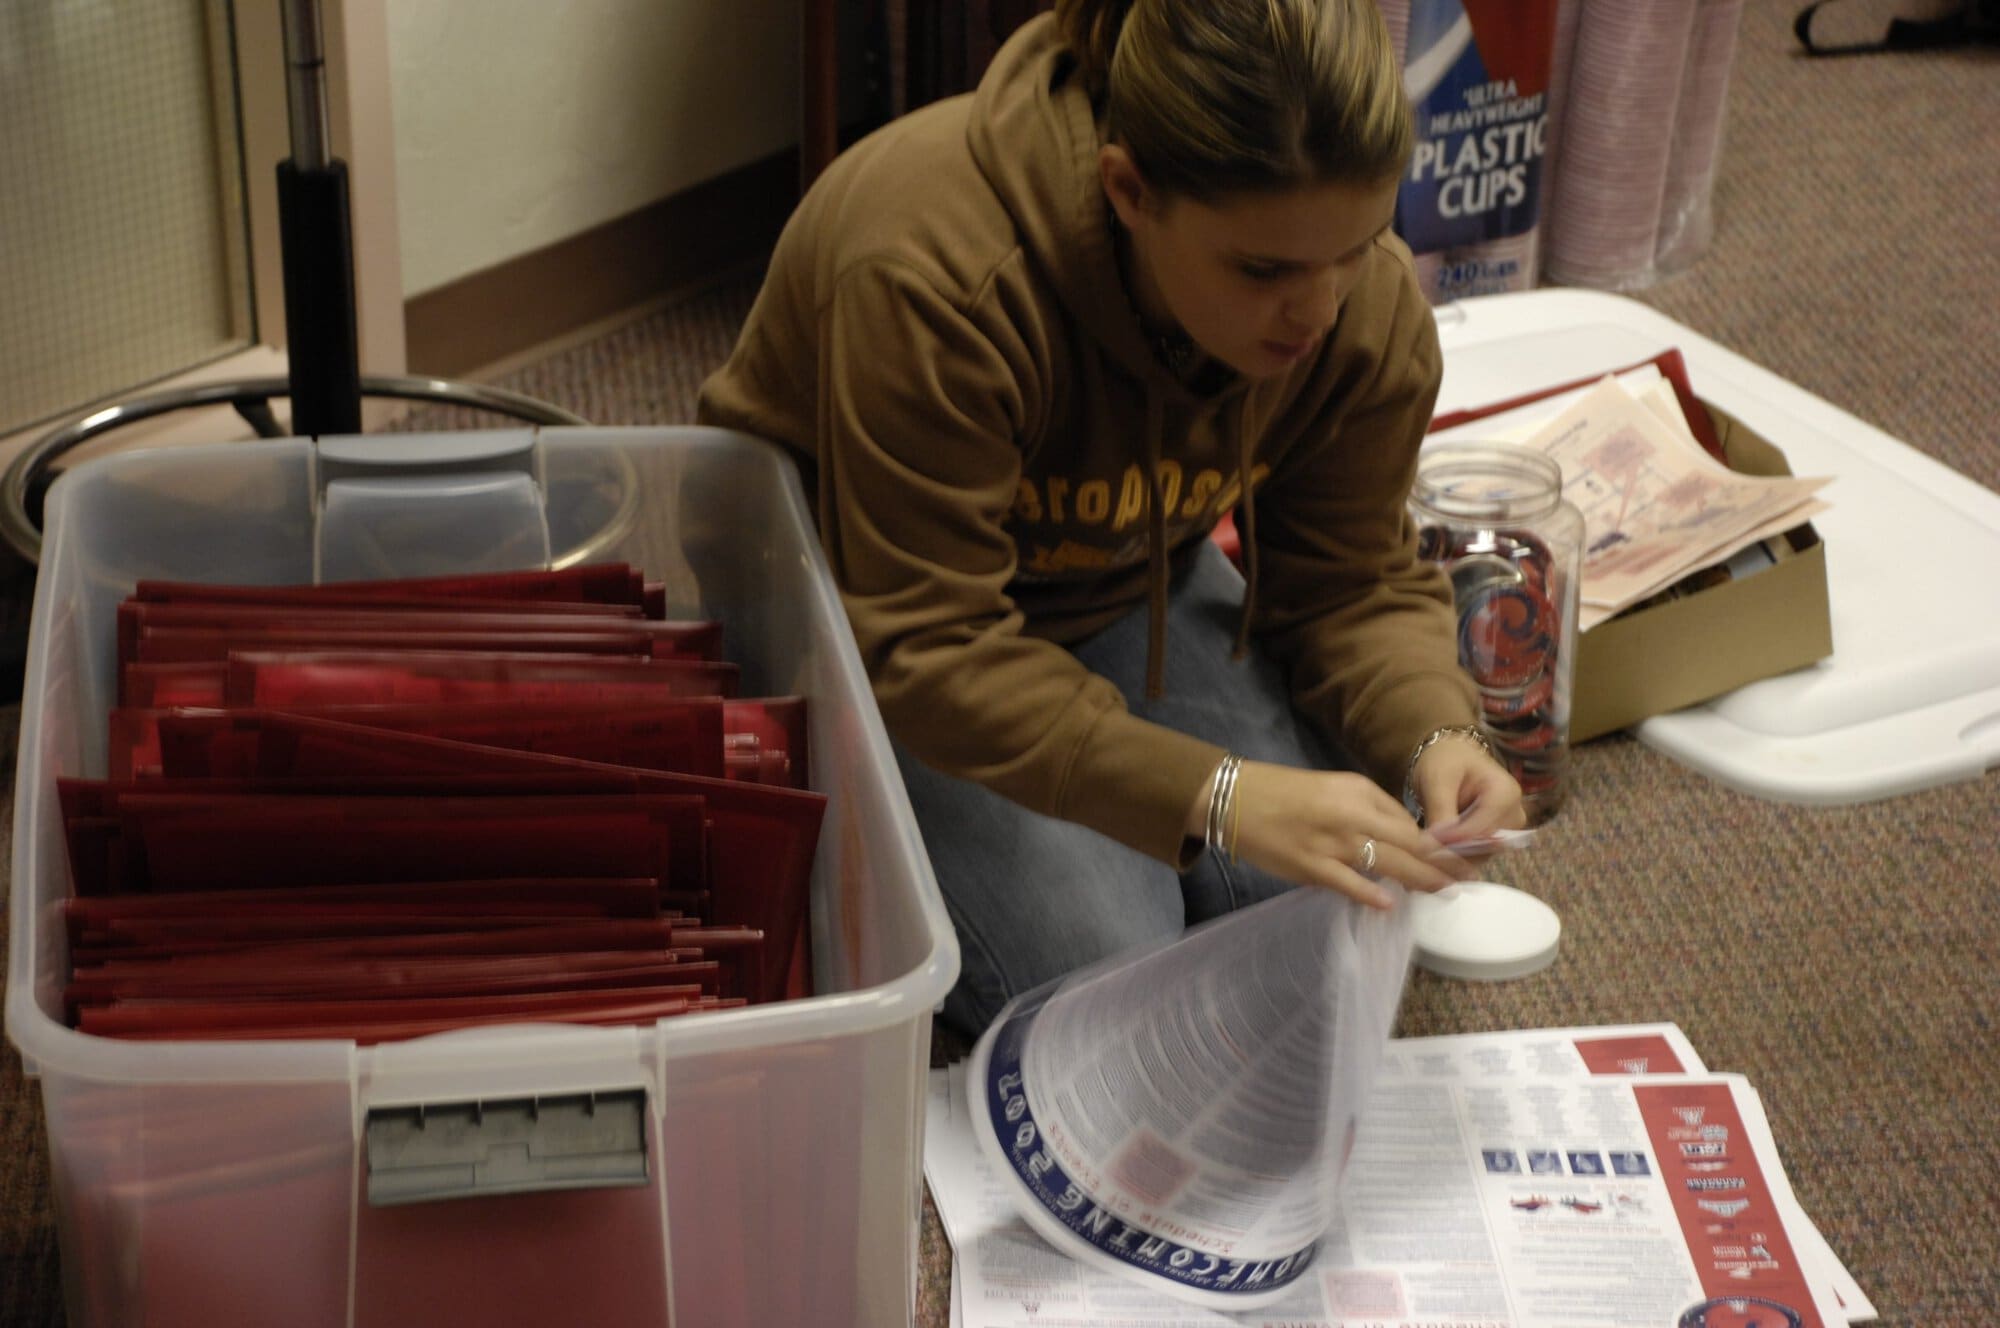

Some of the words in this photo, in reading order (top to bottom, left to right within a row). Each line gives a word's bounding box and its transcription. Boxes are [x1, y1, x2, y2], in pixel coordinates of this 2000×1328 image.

[1430, 92, 1543, 136] HEAVYWEIGHT
[1411, 114, 1547, 181] PLASTIC
[1438, 164, 1526, 219] CUPS
